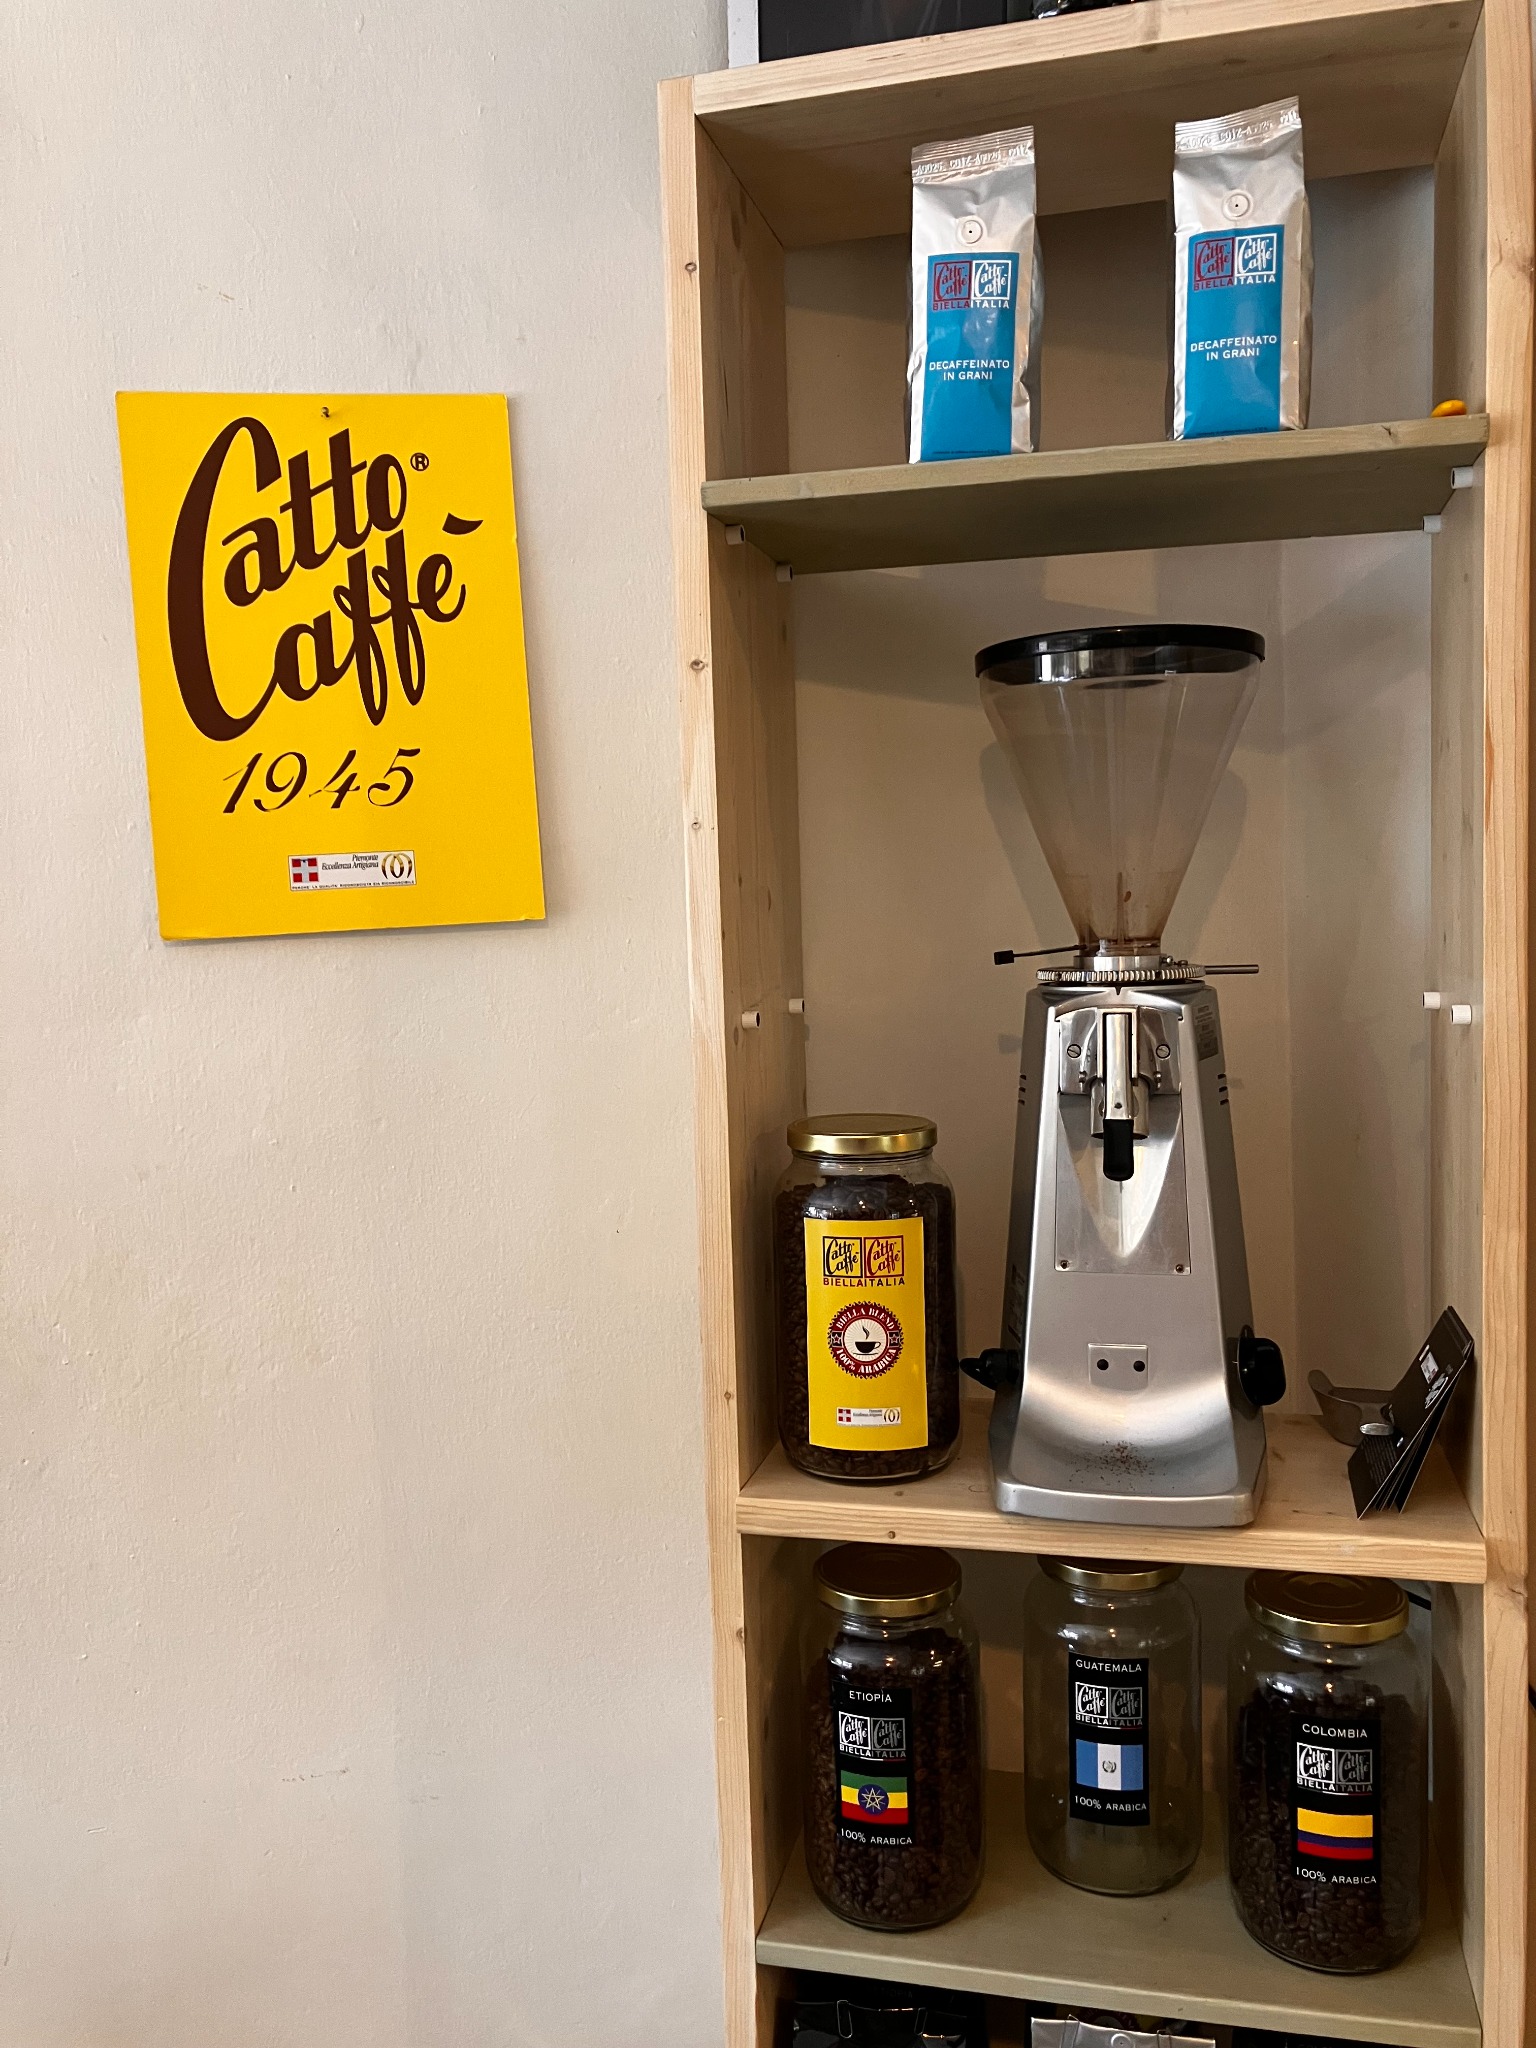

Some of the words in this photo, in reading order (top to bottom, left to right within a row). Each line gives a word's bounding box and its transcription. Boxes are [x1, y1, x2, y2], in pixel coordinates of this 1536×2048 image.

[1190, 335, 1278, 352] DECAFFEINATO
[1206, 351, 1219, 361] IN
[1223, 347, 1260, 359] GRANI
[929, 359, 1010, 371] DECAFFEINATO
[943, 371, 955, 381] IN
[958, 371, 993, 380] GRANI
[168, 511, 484, 741] Caffè
[222, 747, 421, 814] 1945
[321, 862, 351, 870] Eccellenza
[352, 861, 379, 870] Artigiana
[352, 854, 379, 862] Piemonte
[836, 1308, 866, 1329] BIELLA
[869, 1308, 895, 1330] BLEND
[836, 1349, 856, 1370] 100%
[858, 1349, 897, 1374] ARABICA
[1075, 1659, 1142, 1673] GUATEMALA
[849, 1690, 892, 1703] ETIOPIA
[1302, 1723, 1368, 1738] COLOMBIA
[1075, 1795, 1102, 1810] 100%
[1105, 1803, 1147, 1812] ARABICA
[841, 1828, 867, 1843] 100%
[870, 1836, 912, 1845] ARABICA
[1296, 1866, 1327, 1882] 100%
[1331, 1875, 1377, 1885] ARABICA
